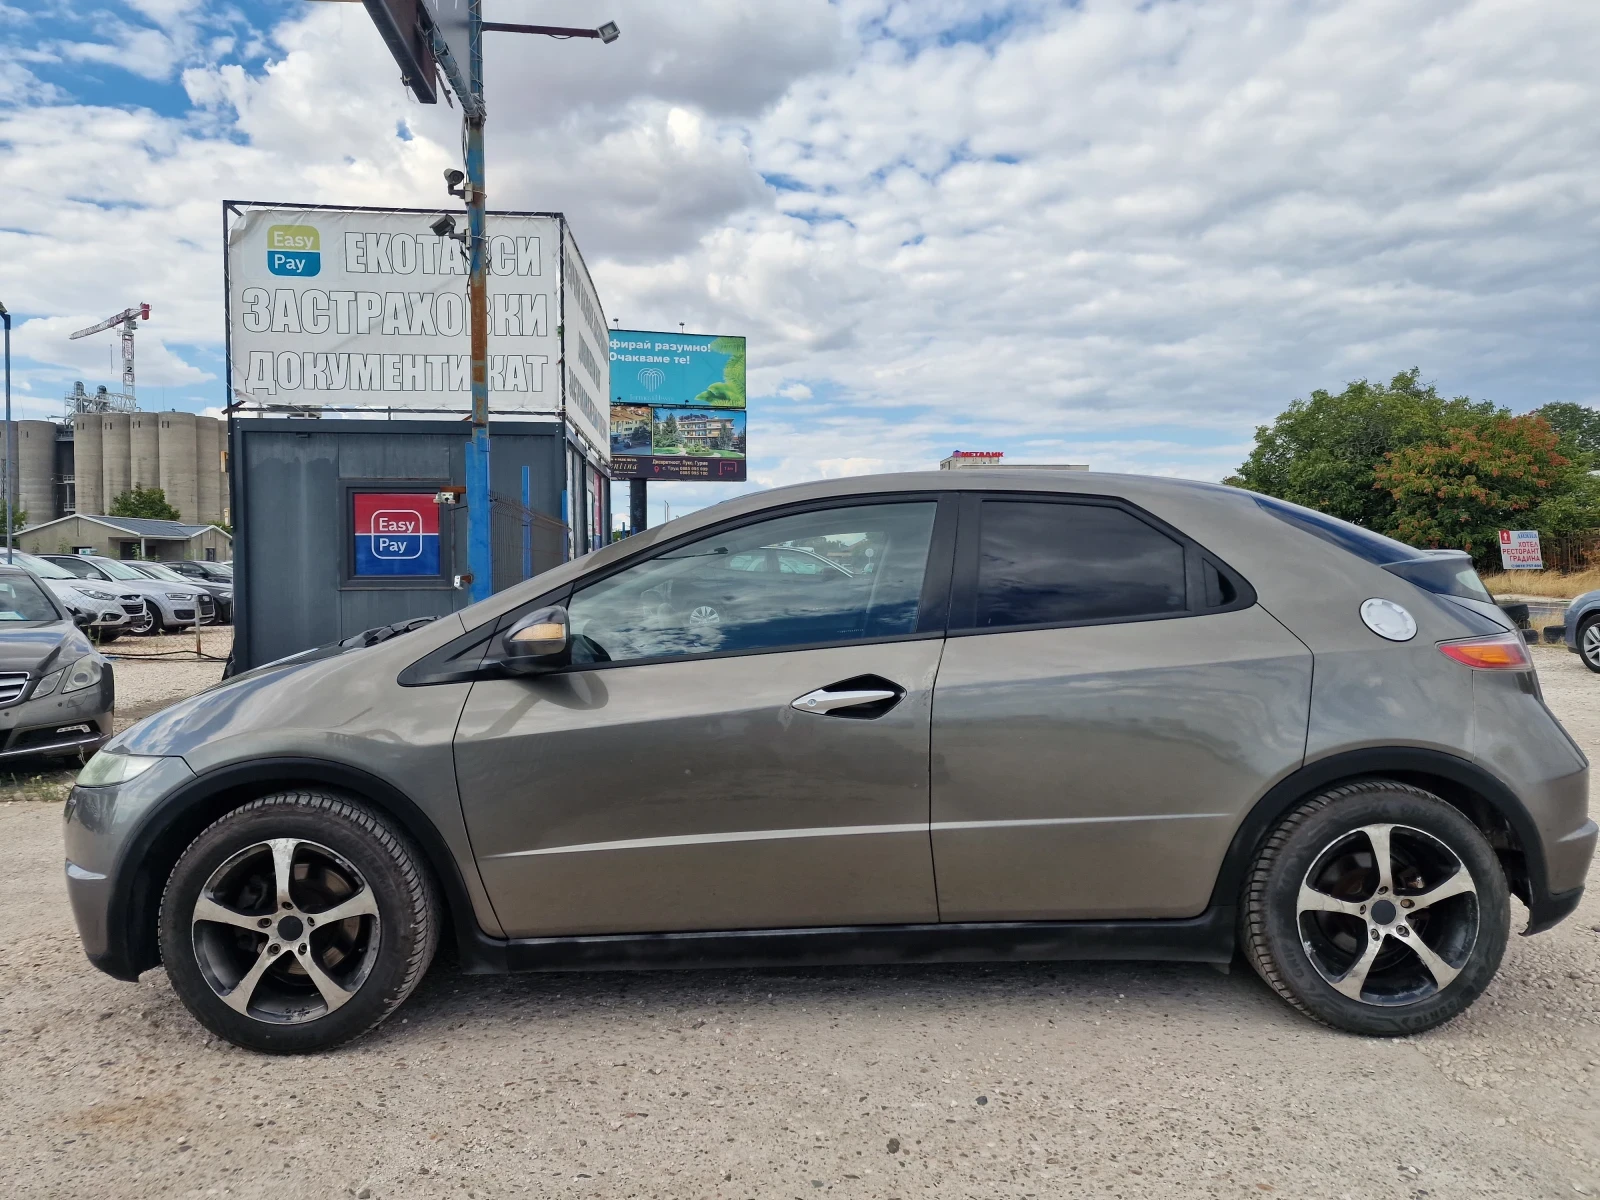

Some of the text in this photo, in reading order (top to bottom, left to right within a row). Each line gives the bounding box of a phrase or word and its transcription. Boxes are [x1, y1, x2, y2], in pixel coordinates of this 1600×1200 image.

[273, 230, 314, 249] Easy
[274, 254, 306, 273] Pay
[655, 342, 711, 353] разумно!
[610, 352, 690, 365] Очакваме те!
[245, 351, 472, 396] ДОКУМЕНТИ
[488, 354, 549, 392] КАТ
[379, 517, 415, 533] Easy
[379, 538, 407, 554] Pay
